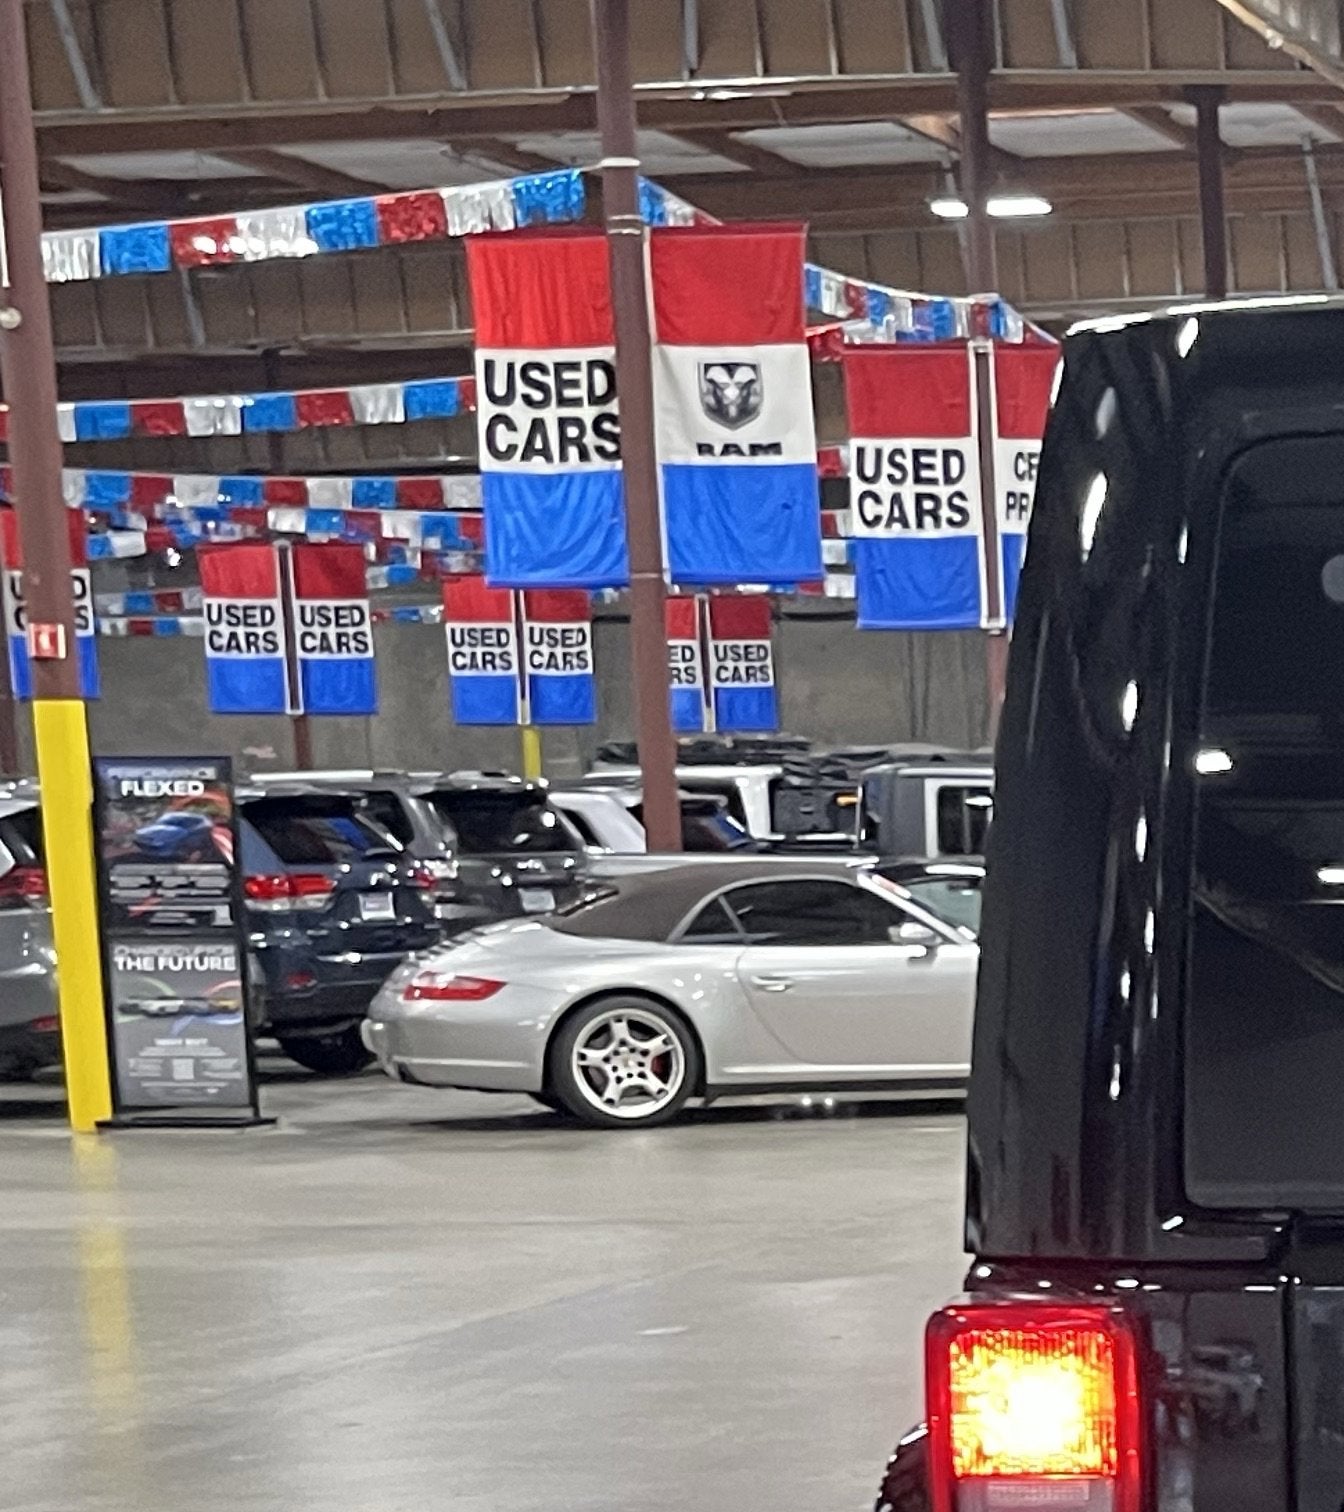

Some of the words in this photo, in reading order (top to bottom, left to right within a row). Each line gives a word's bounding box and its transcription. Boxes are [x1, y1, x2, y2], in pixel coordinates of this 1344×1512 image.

[483, 358, 617, 409] USED
[485, 412, 622, 463] CARS
[696, 441, 783, 457] RAM
[856, 446, 966, 487] USED
[857, 489, 971, 530] CARS
[206, 603, 276, 628] USED
[299, 604, 366, 629] USED
[208, 629, 280, 654] CARS
[299, 630, 370, 655] CARS
[450, 627, 511, 649] USED
[528, 626, 588, 649] USED
[451, 650, 513, 671] CARS
[529, 650, 590, 671] CARS
[668, 645, 696, 664] ED
[713, 644, 770, 663] USED
[670, 665, 698, 686] RS
[715, 664, 771, 684] CARS
[121, 780, 205, 797] FLEXED
[114, 955, 155, 972] THE
[157, 955, 237, 972] FUTURE
